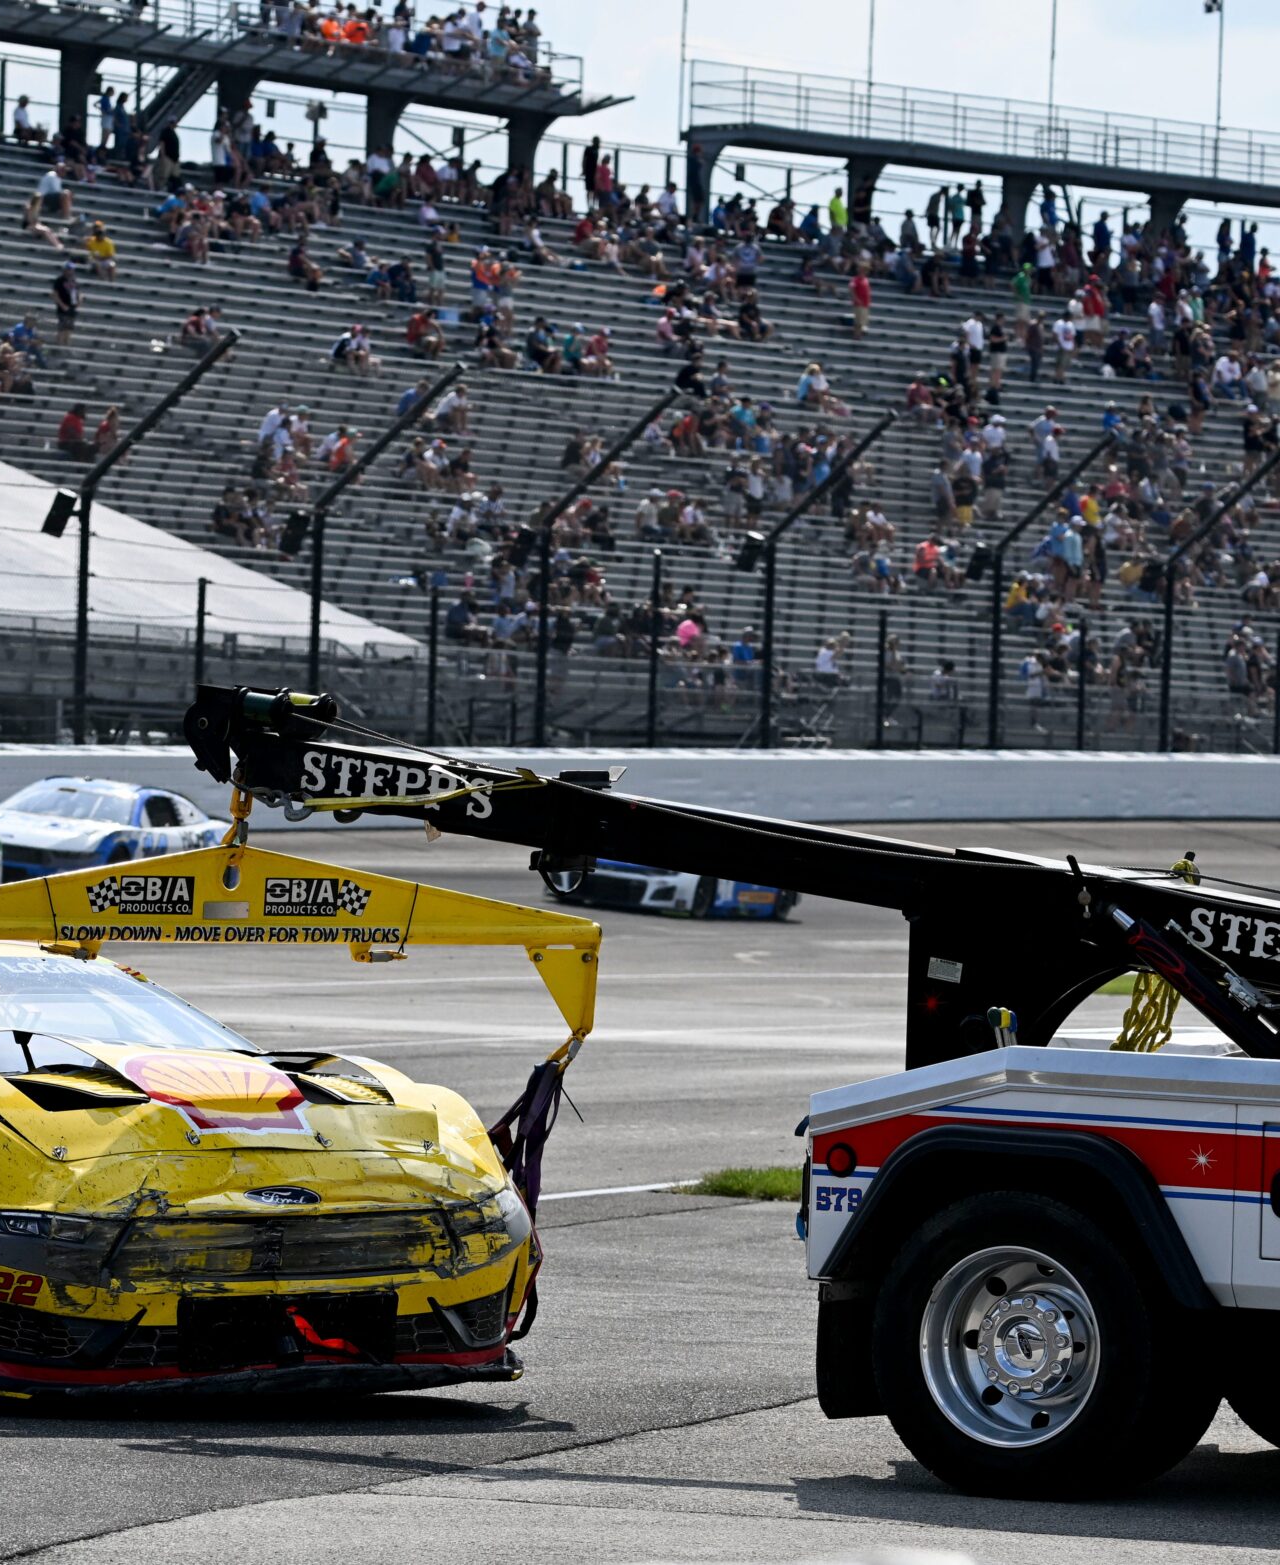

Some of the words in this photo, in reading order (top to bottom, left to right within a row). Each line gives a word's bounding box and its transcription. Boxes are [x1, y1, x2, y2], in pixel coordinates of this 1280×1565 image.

[300, 750, 495, 819] STEPP'S
[147, 877, 189, 902] B/A
[291, 880, 334, 904] B/A
[120, 902, 173, 913] PRODUCTS
[265, 904, 317, 915] PRODUCTS
[60, 926, 106, 941] SLOW
[109, 926, 161, 942] DOWN
[174, 926, 221, 942] MOVE
[224, 927, 265, 942] OVER
[269, 927, 298, 942] FOR
[302, 928, 339, 942] TOW
[342, 928, 400, 943] TRUCKS
[261, 1190, 306, 1205] Ford
[816, 1186, 863, 1213] 579
